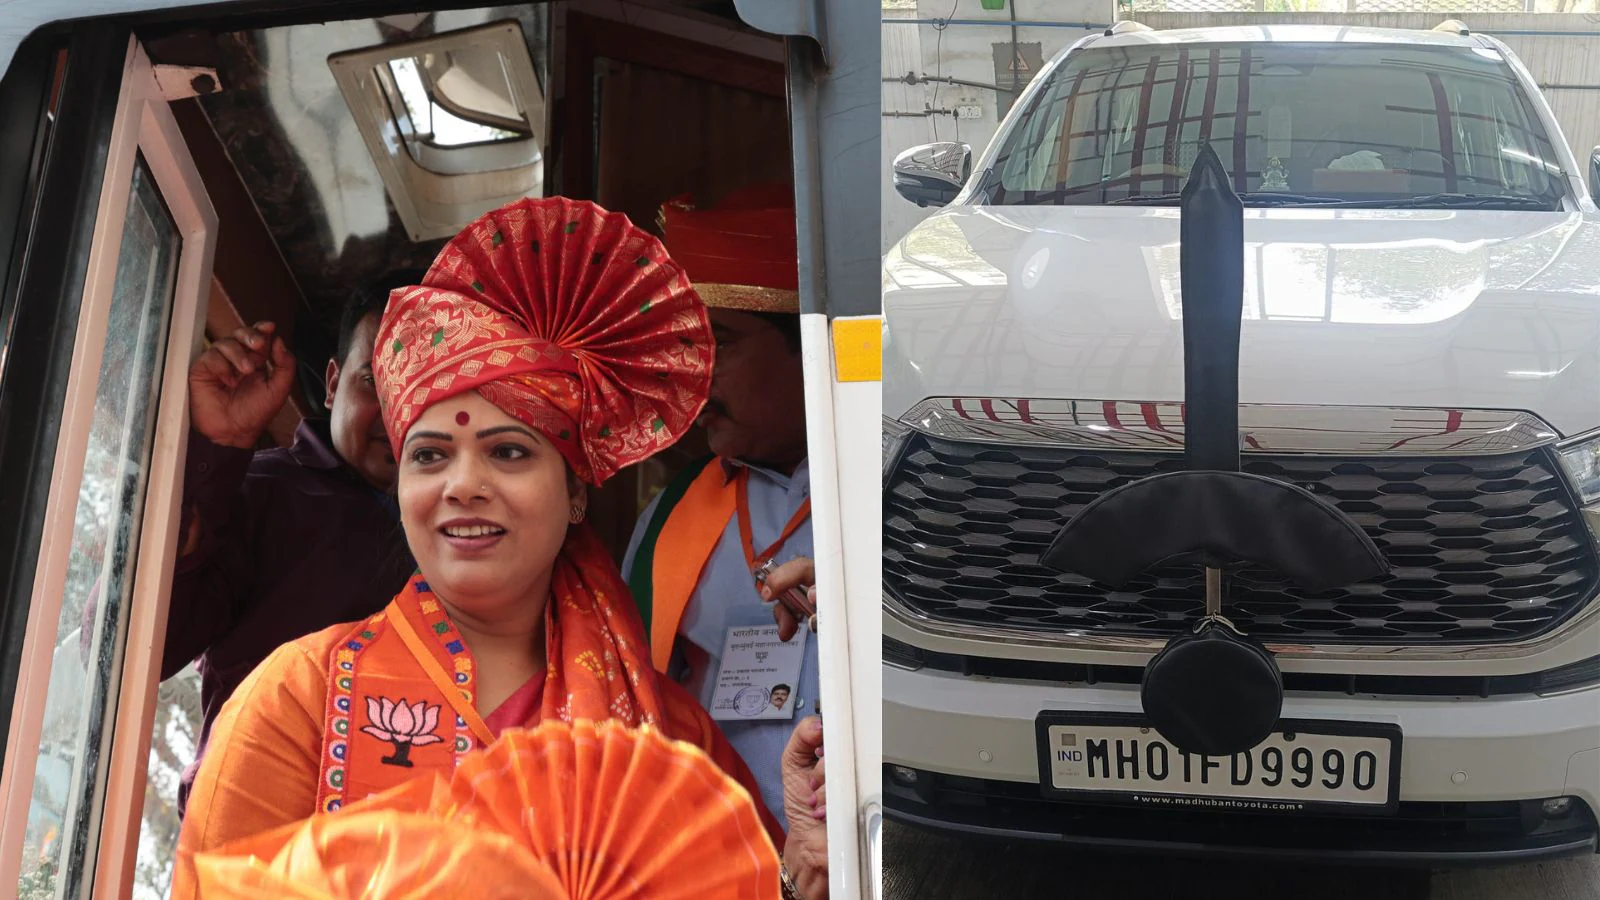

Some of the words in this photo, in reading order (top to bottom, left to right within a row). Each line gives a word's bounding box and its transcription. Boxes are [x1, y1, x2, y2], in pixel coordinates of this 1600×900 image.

[733, 628, 760, 638] भारतीय
[1057, 750, 1083, 762] IND
[1142, 796, 1296, 810] www.madhubantoyota.com
